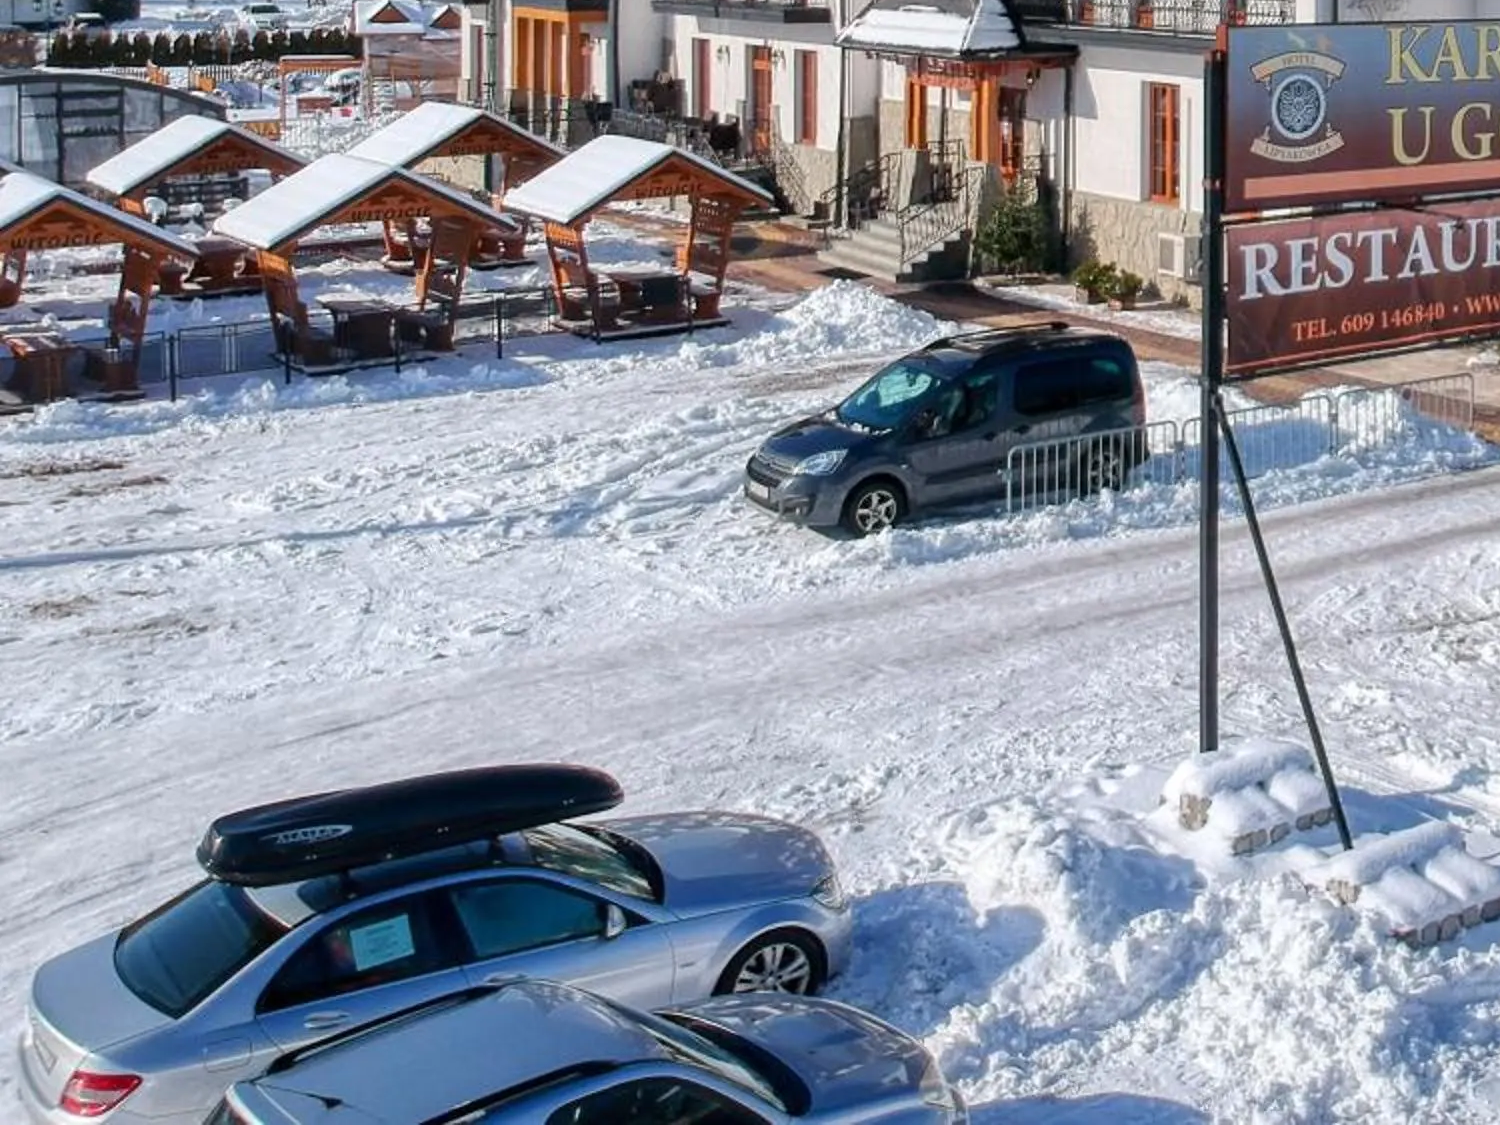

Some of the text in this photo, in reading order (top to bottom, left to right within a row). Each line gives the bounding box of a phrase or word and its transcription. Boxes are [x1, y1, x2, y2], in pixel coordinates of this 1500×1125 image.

[1386, 105, 1436, 166] U
[1292, 318, 1337, 342] TEL.
[1340, 312, 1375, 335] 609
[1381, 301, 1446, 329] 146840
